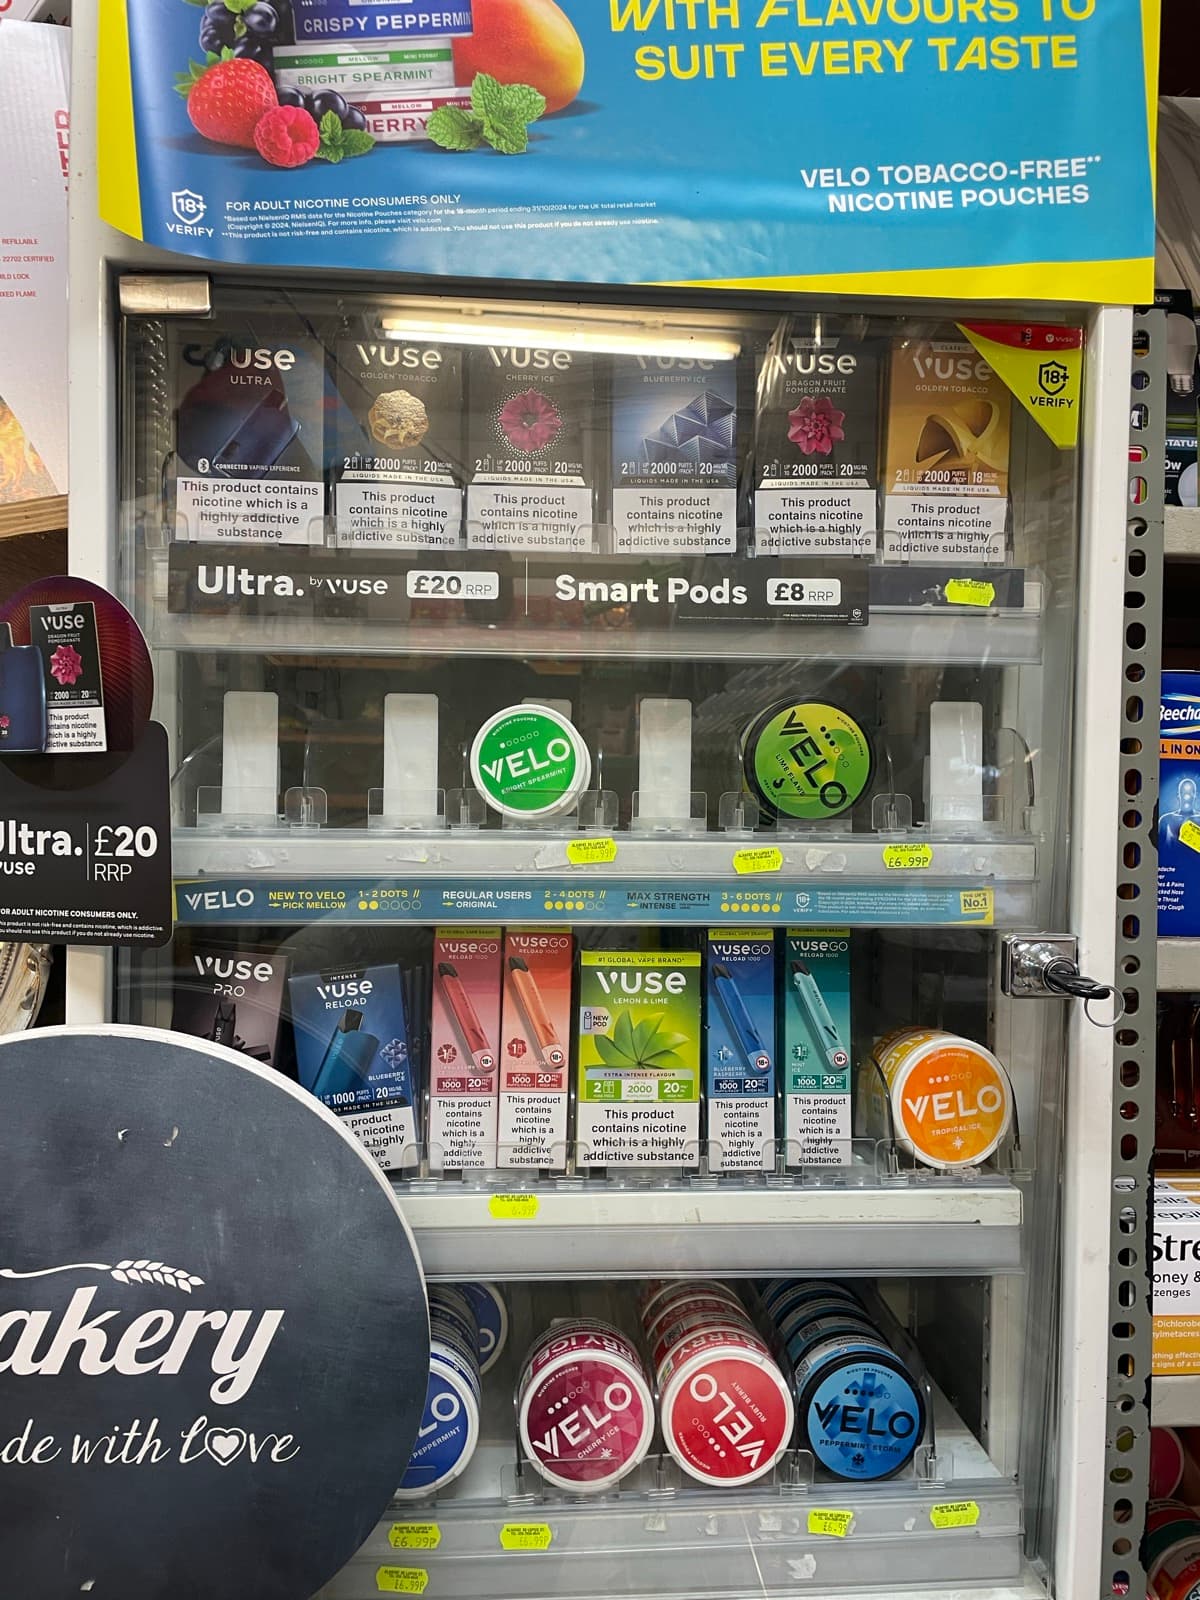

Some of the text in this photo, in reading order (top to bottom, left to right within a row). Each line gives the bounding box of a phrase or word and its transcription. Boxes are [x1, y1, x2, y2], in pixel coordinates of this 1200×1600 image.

[304, 11, 471, 32] CRISPY PEPPERMIN
[610, 0, 1095, 31] WITH FLAVOURS TO
[635, 34, 1078, 80] SUIT EVERY TASTE
[298, 70, 433, 85] BRIGHT SPEARMINT
[801, 167, 871, 188] VELO
[177, 198, 207, 213] 18+
[226, 194, 461, 211] FOR ADULT NICOTINE CONSUMERS ONLY
[828, 184, 1089, 213] NICOTINE POUCHES
[166, 223, 213, 237] VERIFY
[230, 376, 272, 386] ULTRA
[360, 371, 438, 383] GOLDEN TOBACCO
[506, 374, 538, 382] CHERRY
[1044, 368, 1069, 384] 18+
[786, 386, 847, 394] POMEGRANATE
[1030, 395, 1074, 408] VERIFY
[181, 481, 319, 496] This product contains
[192, 497, 308, 510] nicotine which is a
[200, 511, 300, 525] highly addictive
[217, 525, 282, 540] substance
[197, 565, 304, 597] Ultra.
[309, 576, 323, 588] by
[413, 574, 462, 595] £20
[466, 585, 492, 595] RRP
[555, 575, 834, 604] Smart Pods £8 RRP
[1160, 705, 1200, 720] Beecha
[1171, 744, 1181, 753] IN
[1185, 745, 1200, 754] ON
[481, 738, 570, 784] VELO
[779, 709, 847, 809] VELO
[528, 768, 566, 785] SPEARMINT
[94, 825, 158, 858] £20
[94, 863, 132, 882] RRP
[185, 889, 255, 911] VELO
[443, 891, 532, 899] REGULAR USERS
[627, 892, 710, 900] MAX STRENGTH
[963, 897, 988, 907] No.1
[70, 910, 116, 918] CONSUMERS
[330, 973, 357, 981] INTENSE
[213, 984, 245, 997] PRO
[325, 998, 367, 1010] RELOAD
[368, 1071, 405, 1081] BLUEBERRY
[333, 1087, 388, 1105] 1000 20
[905, 1085, 1001, 1124] VELO
[932, 1125, 968, 1136] TROPICAL
[1153, 1233, 1200, 1261] Stre
[1153, 1274, 1188, 1285] oney
[1154, 1290, 1190, 1298] zenges
[0, 1285, 286, 1405] akery
[418, 1392, 460, 1438] LO
[532, 1382, 632, 1458] VELO
[689, 1372, 766, 1469] VELO
[813, 1401, 915, 1438] VELO
[0, 1418, 62, 1464] de
[71, 1418, 171, 1464] with
[413, 1426, 461, 1459] PEPPERMINT
[577, 1426, 620, 1459] CHERRY ICE
[819, 1439, 870, 1449] PEPPERMINT
